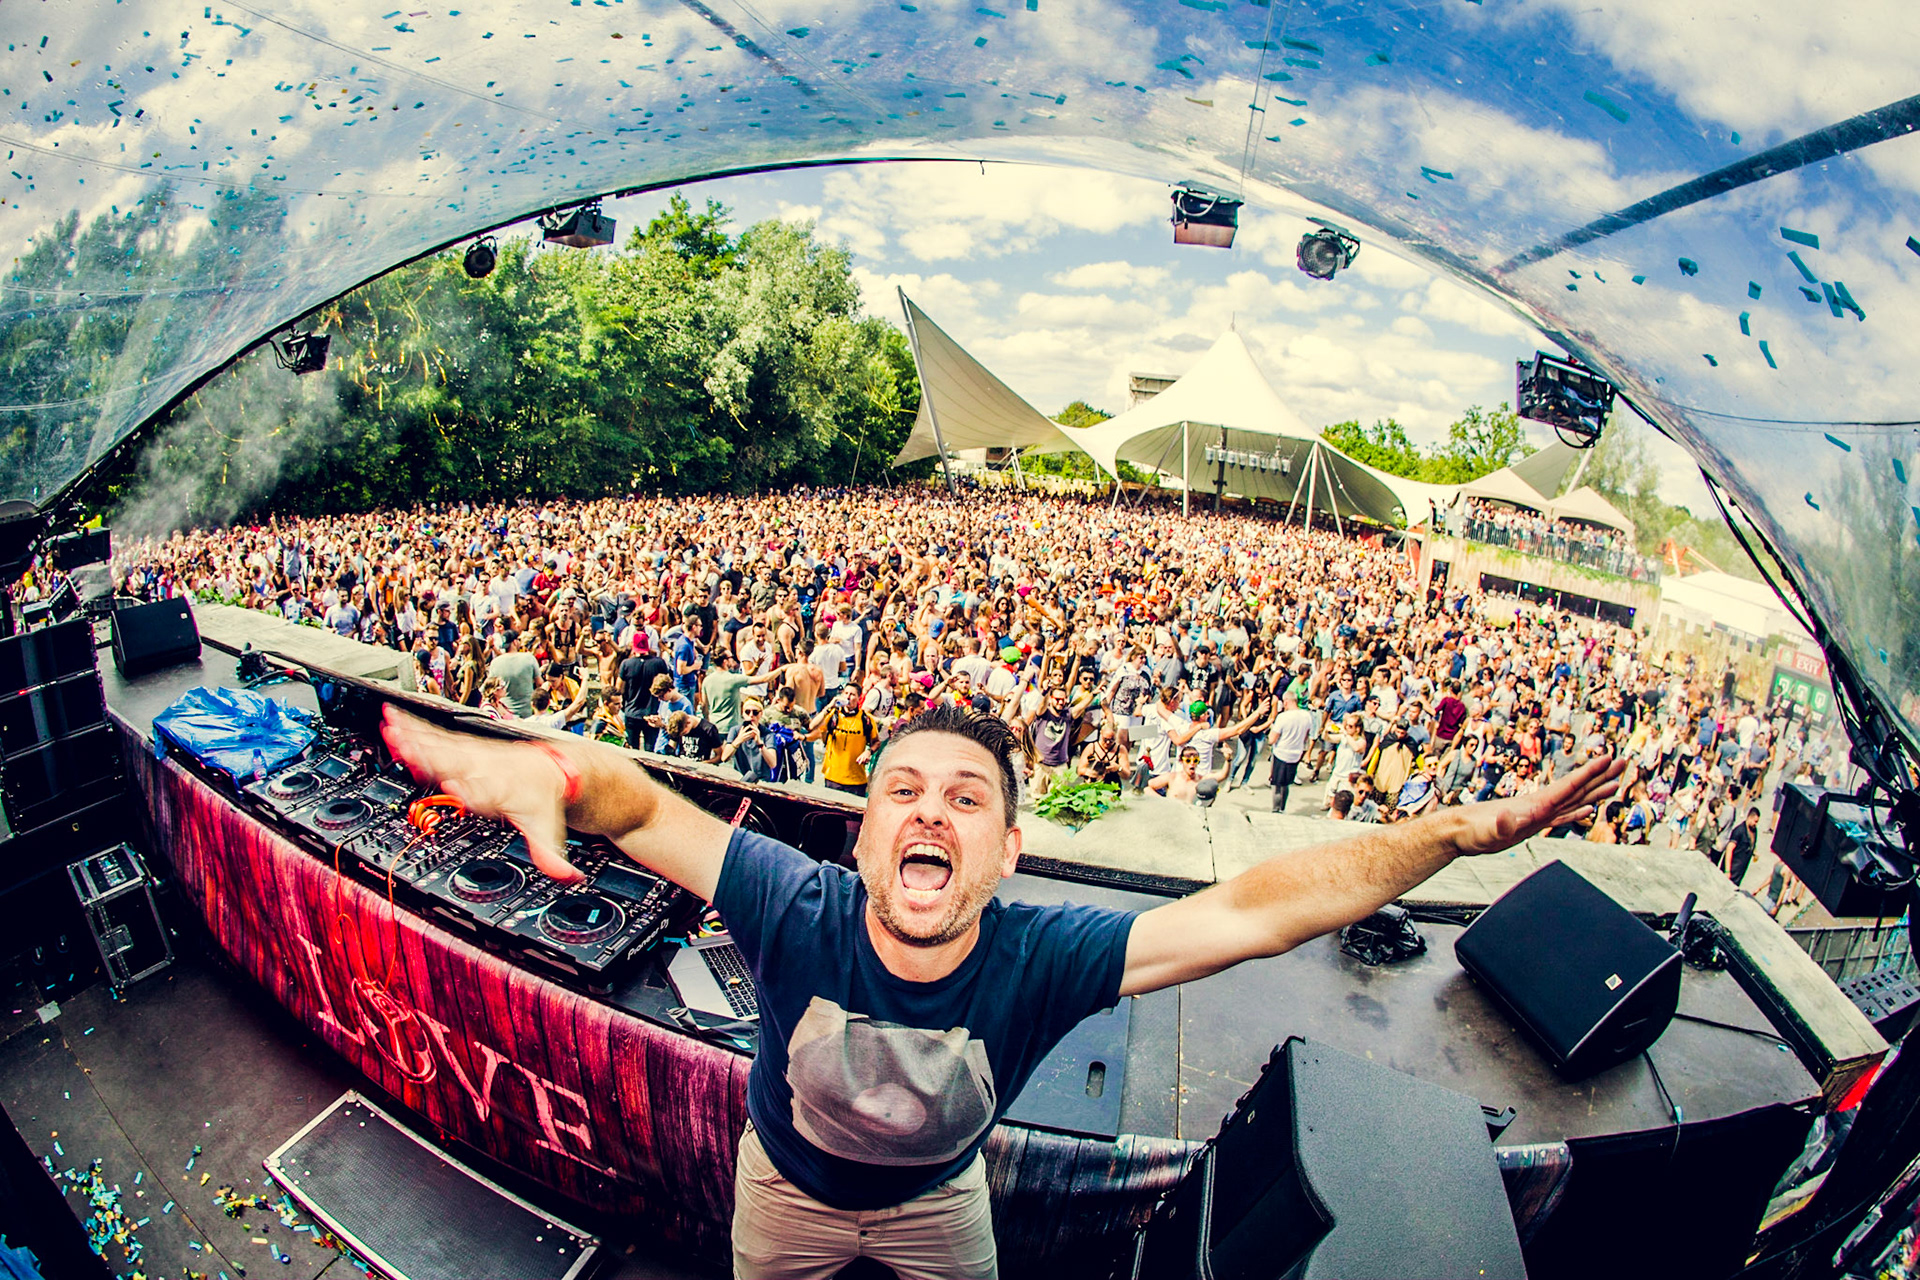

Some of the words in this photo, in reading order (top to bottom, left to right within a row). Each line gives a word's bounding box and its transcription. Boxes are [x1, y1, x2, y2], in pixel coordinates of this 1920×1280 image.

[1796, 659, 1820, 675] EXIT
[627, 927, 661, 960] Pioneer
[659, 918, 670, 932] DJ
[297, 933, 617, 1178] LOVE
